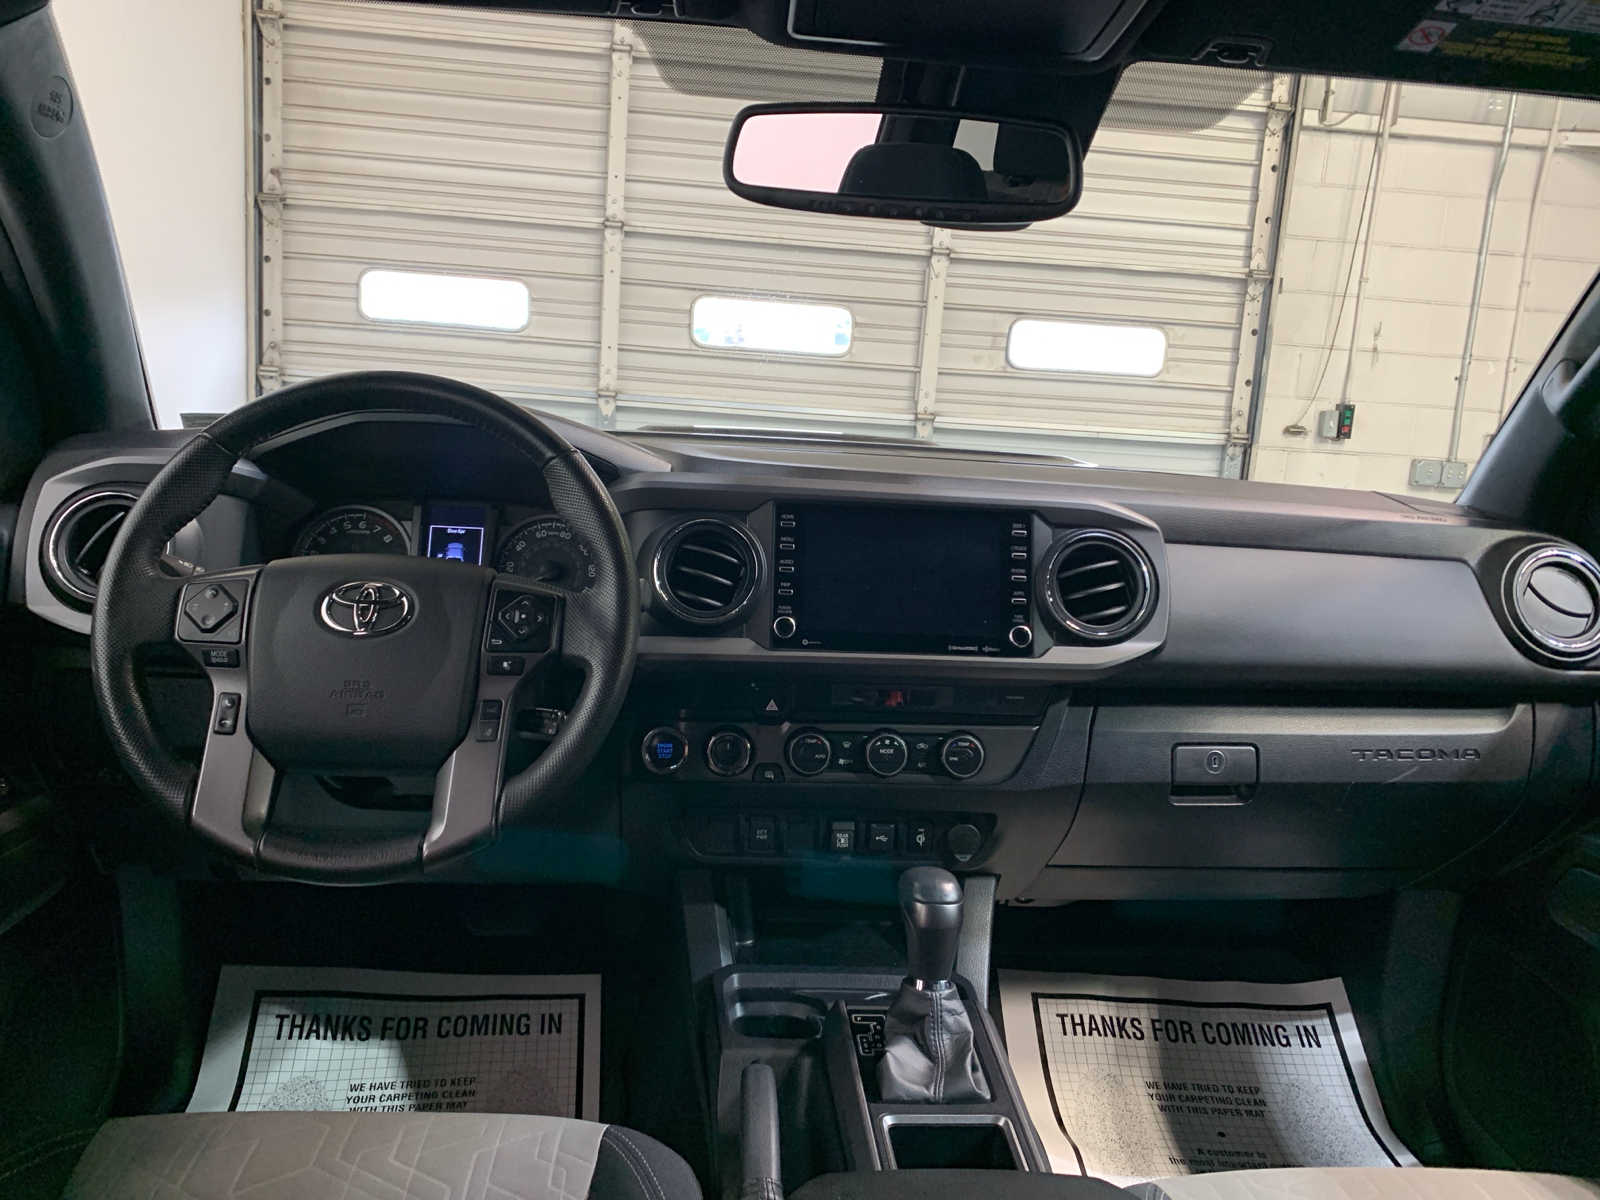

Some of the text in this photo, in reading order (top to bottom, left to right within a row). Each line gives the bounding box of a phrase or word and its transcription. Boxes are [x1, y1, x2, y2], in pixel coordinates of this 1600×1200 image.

[1351, 748, 1480, 762] TACOMA
[275, 1012, 563, 1042] THANKS FOR COMING IN
[1056, 1013, 1322, 1049] THANKS FOR COMING IN
[349, 1076, 476, 1093] WE HAVE TRIED TO KEEP
[1145, 1080, 1260, 1095] WE HAVE TRIED TO KEEP
[346, 1088, 476, 1105] YOUR CARPETING CLEAN
[1147, 1092, 1267, 1107] YOUR CARPETING CLEAN
[381, 1103, 405, 1113] THIS
[408, 1101, 442, 1113] PAPER
[446, 1101, 468, 1112] MAT
[1157, 1104, 1184, 1114] WITH
[1168, 1156, 1186, 1166] the
